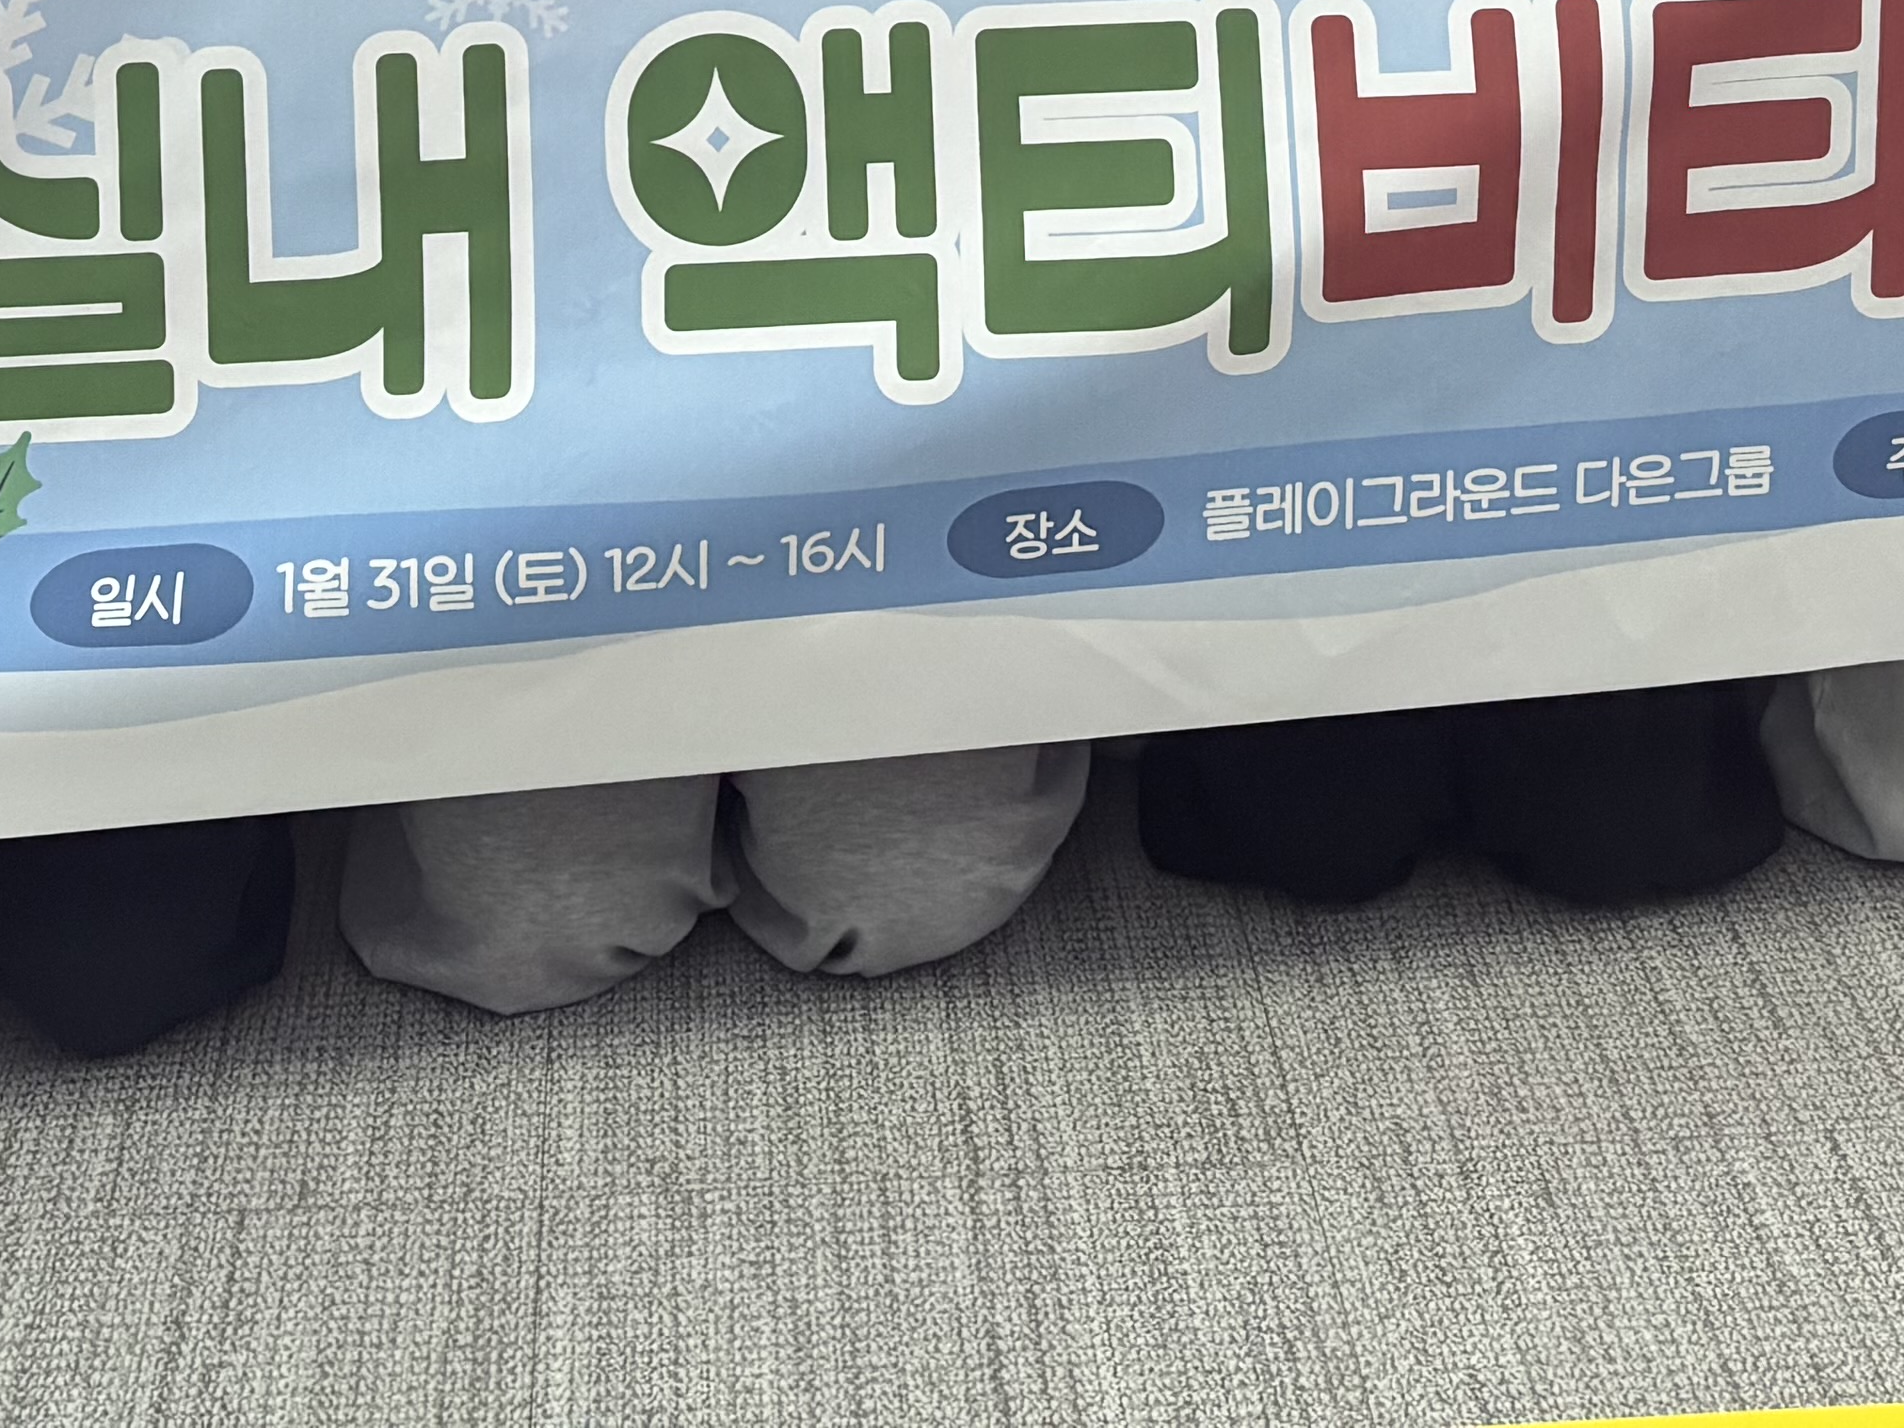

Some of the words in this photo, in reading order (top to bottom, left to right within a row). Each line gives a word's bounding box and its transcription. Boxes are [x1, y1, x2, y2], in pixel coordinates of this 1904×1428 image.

[91, 572, 184, 627] 일시
[277, 557, 349, 617] 1월
[367, 553, 474, 611] 31일
[495, 547, 586, 605] (토)
[604, 540, 707, 592] 12시
[781, 523, 884, 575] 16시
[1006, 509, 1099, 559] 장소
[1203, 464, 1560, 540] 플레이그라운드
[1576, 446, 1774, 507] 다은그룹
